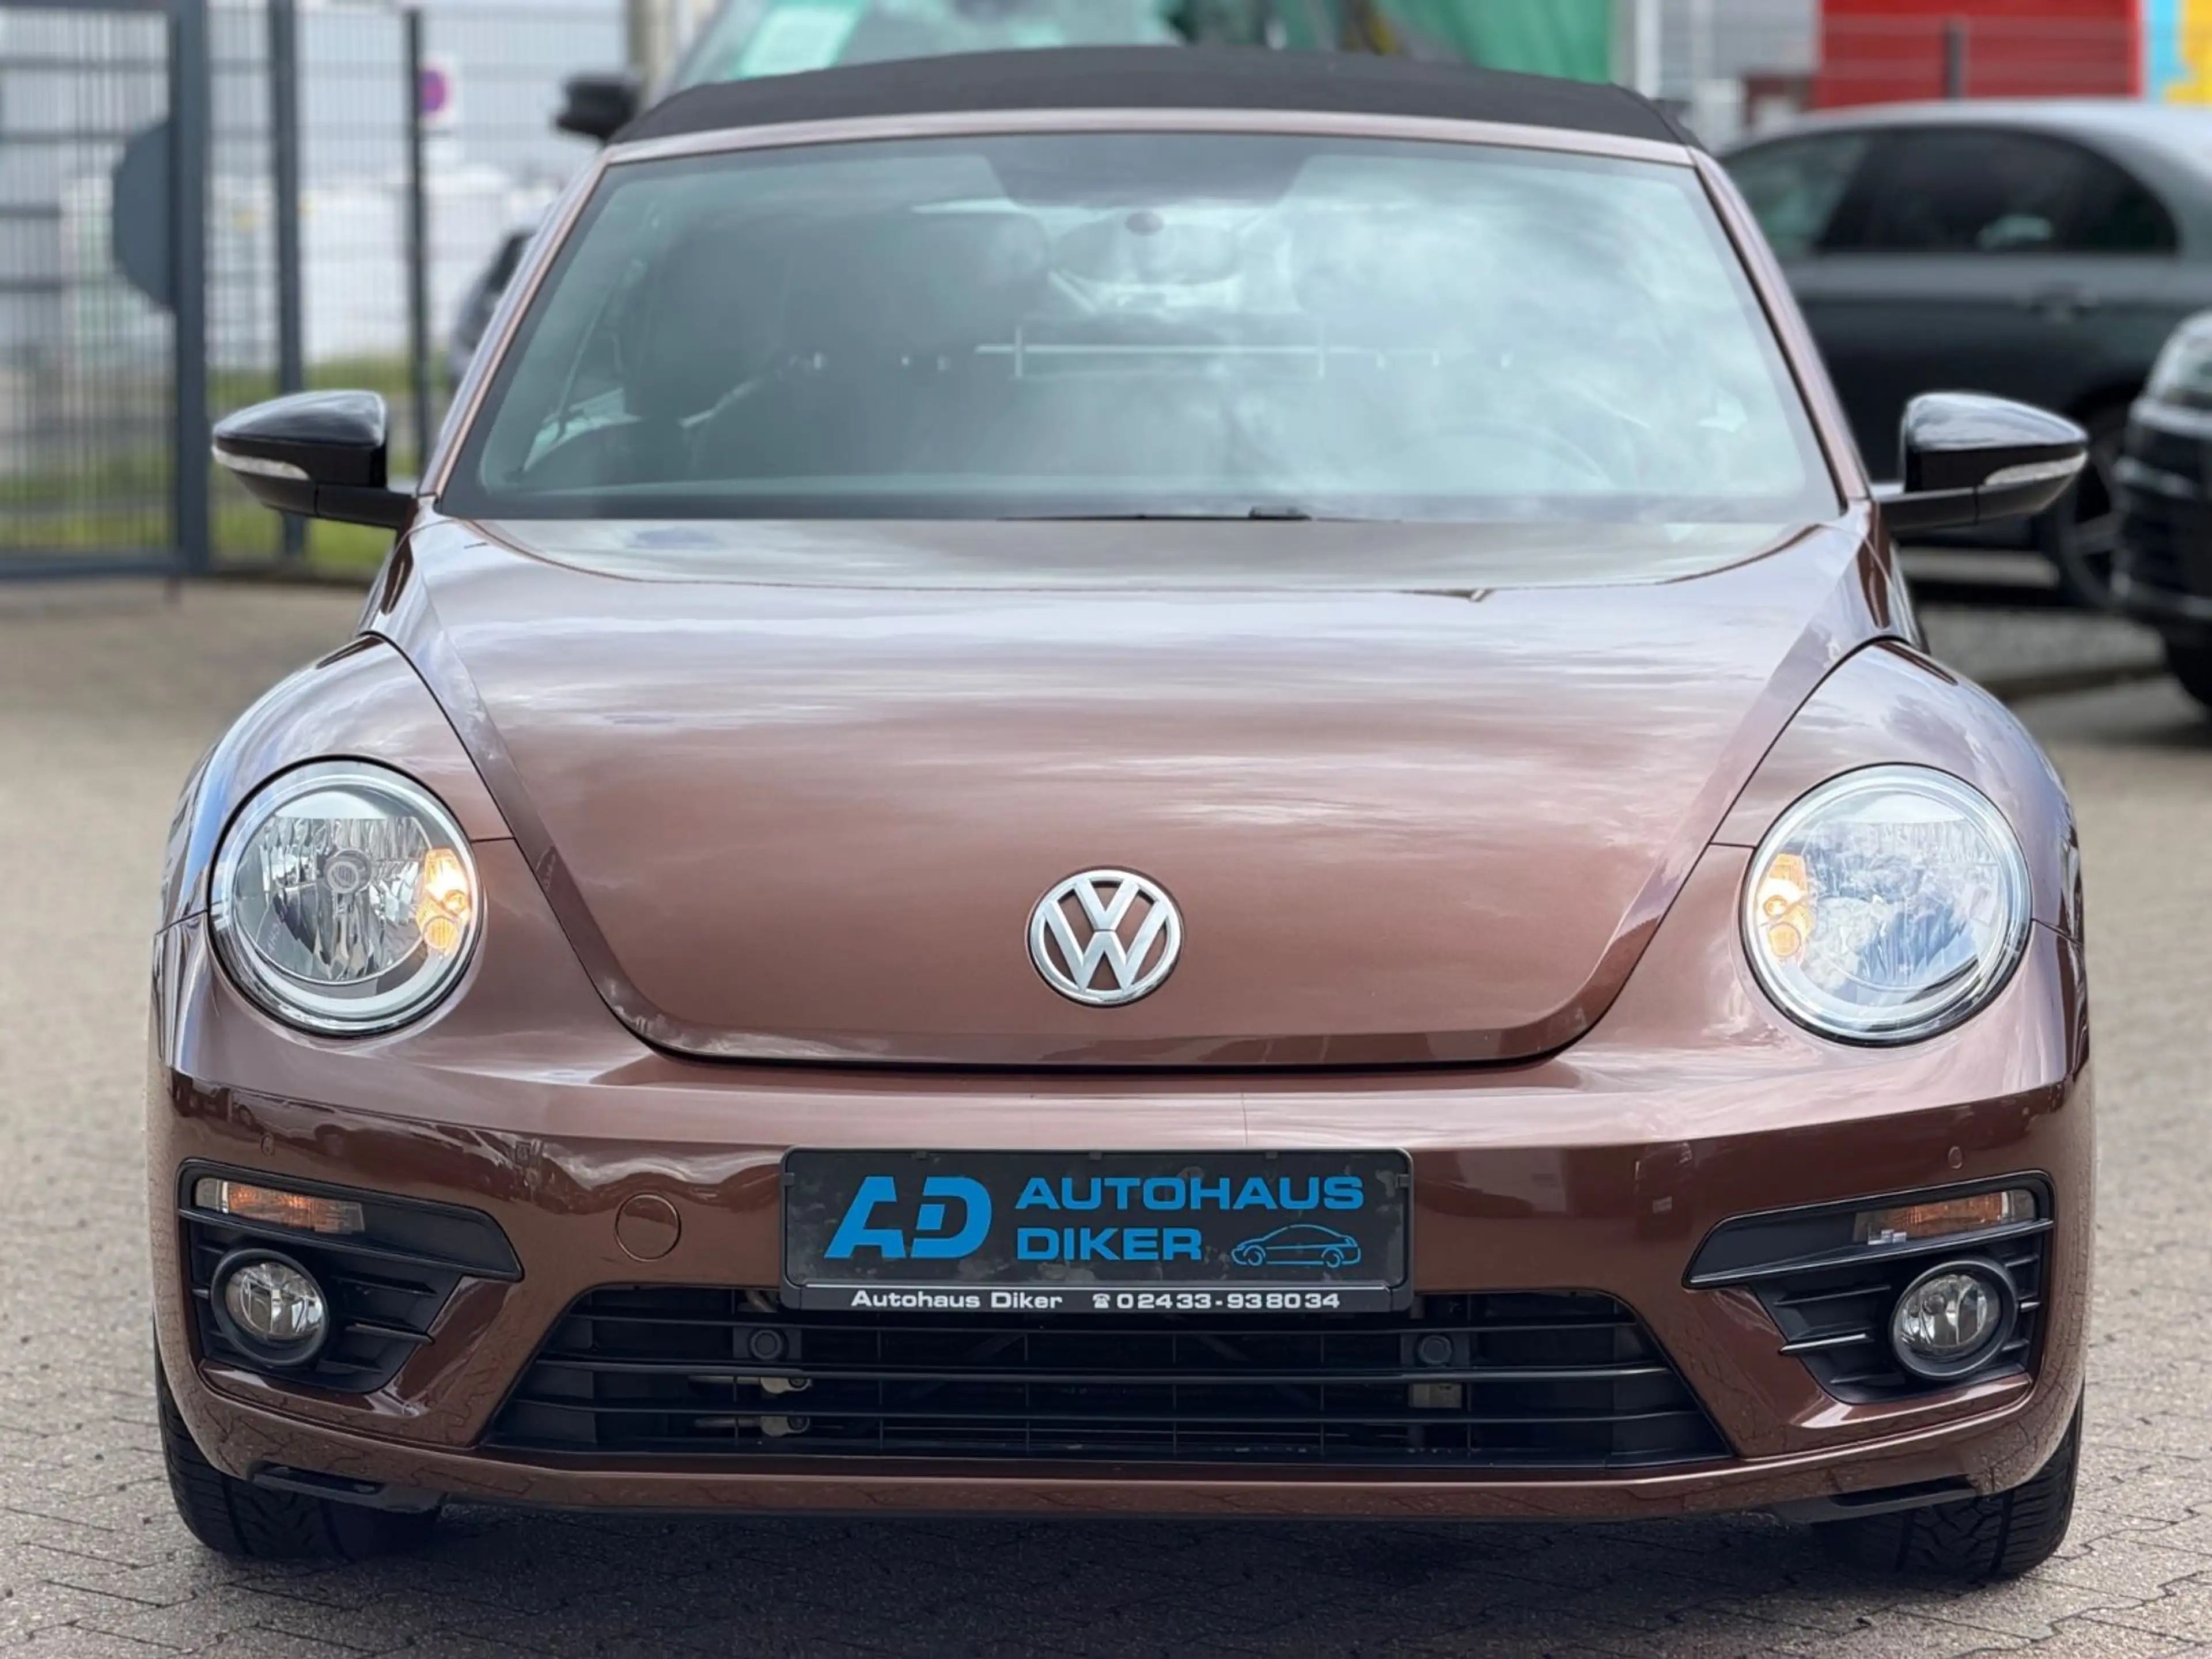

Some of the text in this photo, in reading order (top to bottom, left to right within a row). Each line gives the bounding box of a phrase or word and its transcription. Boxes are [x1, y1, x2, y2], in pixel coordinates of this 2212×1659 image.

[1030, 870, 1180, 1002] VW
[1017, 1176, 1365, 1211] AUTOHAUS
[824, 1176, 993, 1260] AD
[1017, 1226, 1203, 1262] DIKER
[851, 1290, 980, 1308] Autohaus
[991, 1291, 1063, 1309] Diker
